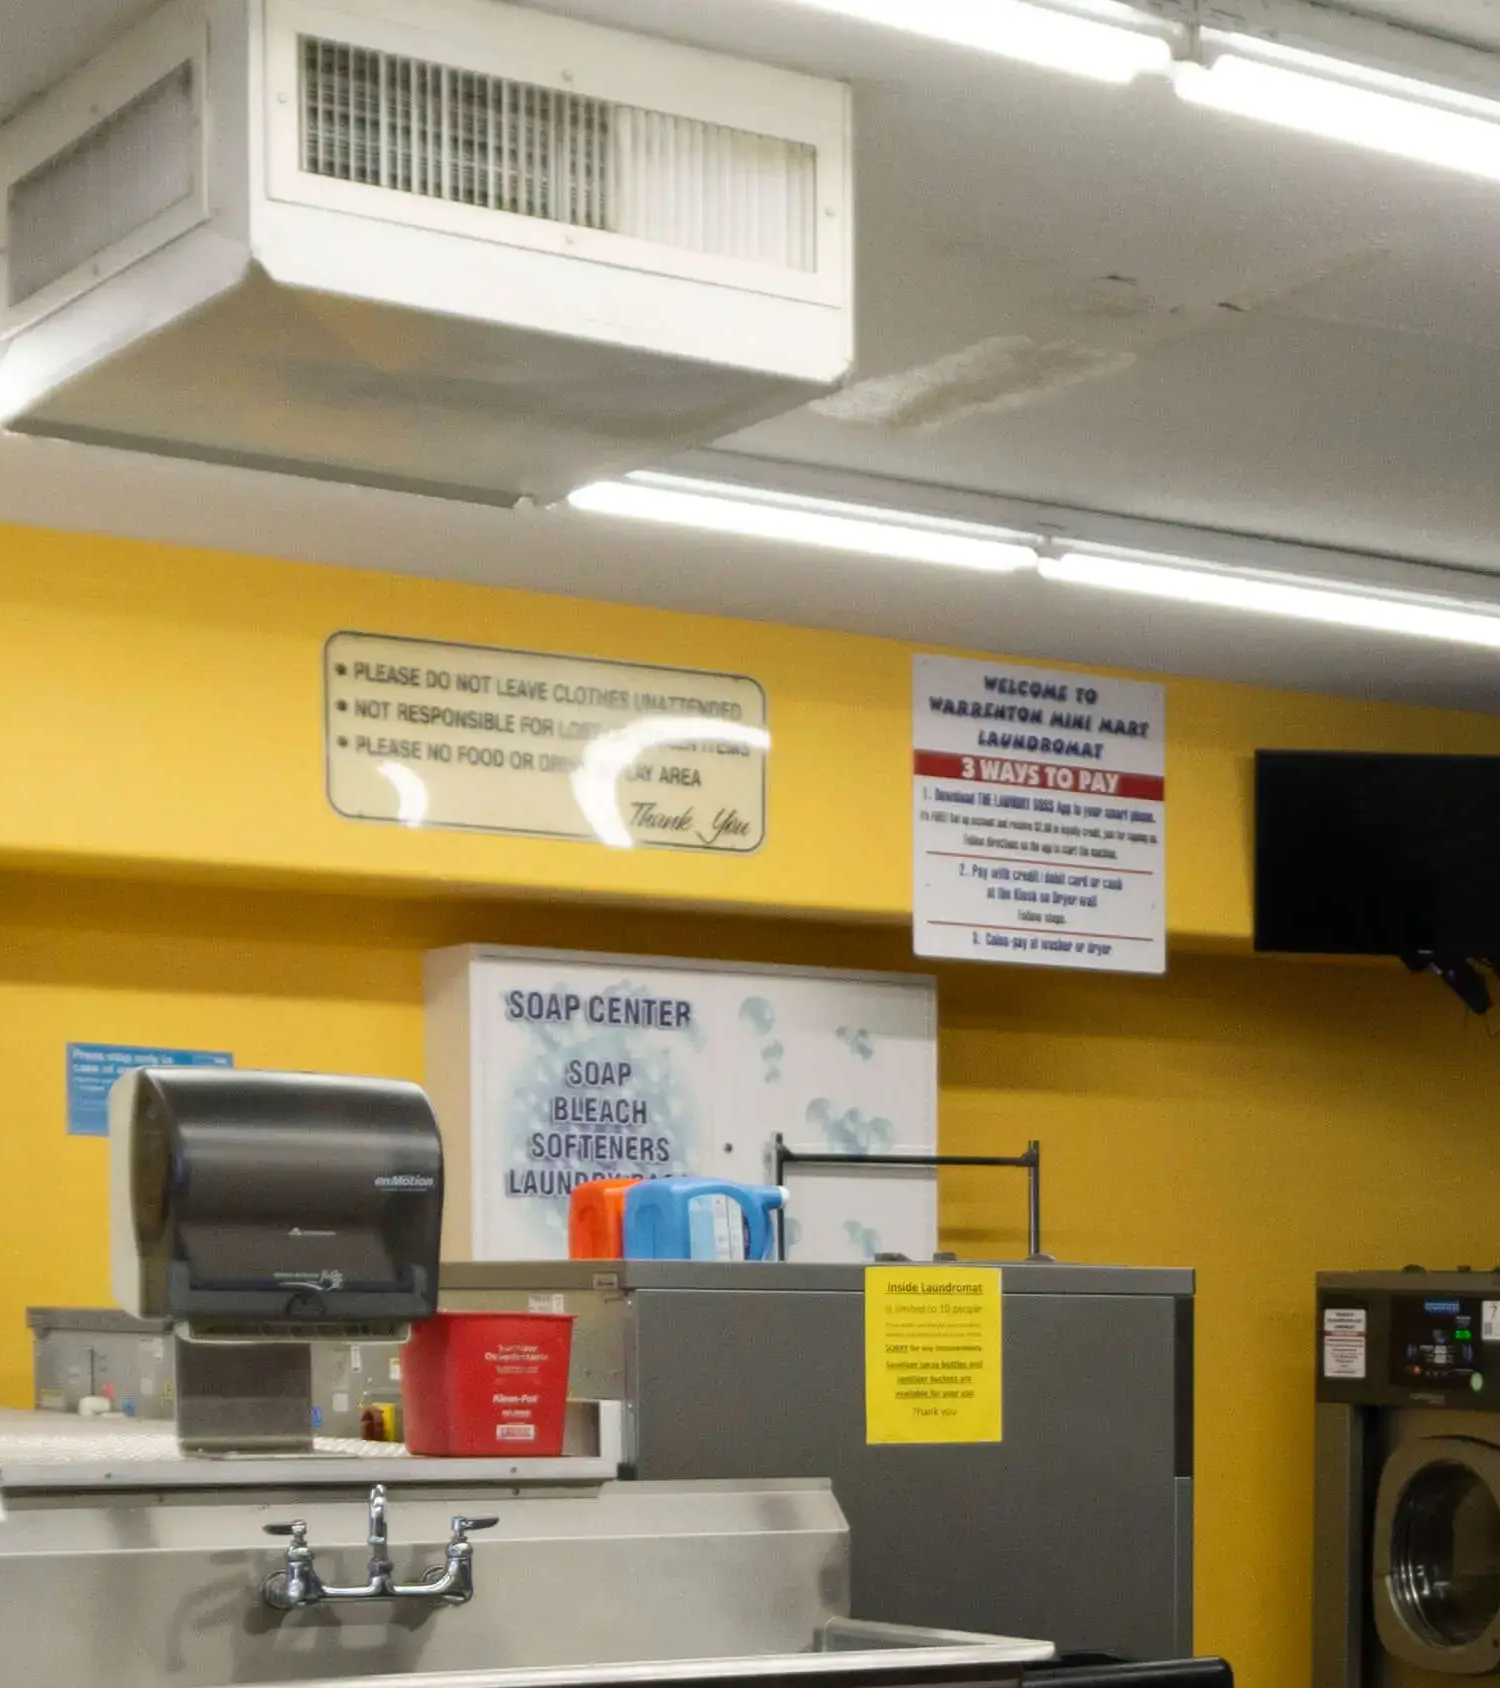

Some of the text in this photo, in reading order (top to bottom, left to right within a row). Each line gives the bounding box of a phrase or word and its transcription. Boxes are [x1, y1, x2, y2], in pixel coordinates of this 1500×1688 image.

[354, 661, 743, 719] PLEASE DO NOT LEAVE CLOTHES UNATTENDED
[983, 675, 1097, 705] WELCOME TO
[355, 698, 391, 719] NOT
[398, 703, 515, 733] RESPONSIBLE
[520, 716, 553, 736] FOR
[928, 696, 1150, 739] WARRENTON MINI MART
[977, 730, 1104, 760] LAUNDROMAT
[355, 735, 702, 786] PLEASE NO FOOD OR AREA
[960, 757, 1120, 794] 3 WAYS TO PAY
[630, 802, 750, 844] Thank You
[972, 864, 988, 880] Pay
[991, 866, 1009, 880] with
[1068, 873, 1087, 887] card
[1090, 877, 1100, 888] or
[1053, 891, 1077, 907] Dryer
[509, 990, 691, 1027] SOAP CENTER
[568, 1060, 631, 1086] SOAP
[554, 1097, 647, 1124] BLEACH
[531, 1133, 670, 1161] SOFTENERS
[509, 1169, 621, 1195] LAUN
[887, 1282, 983, 1295] Inside Laundromat
